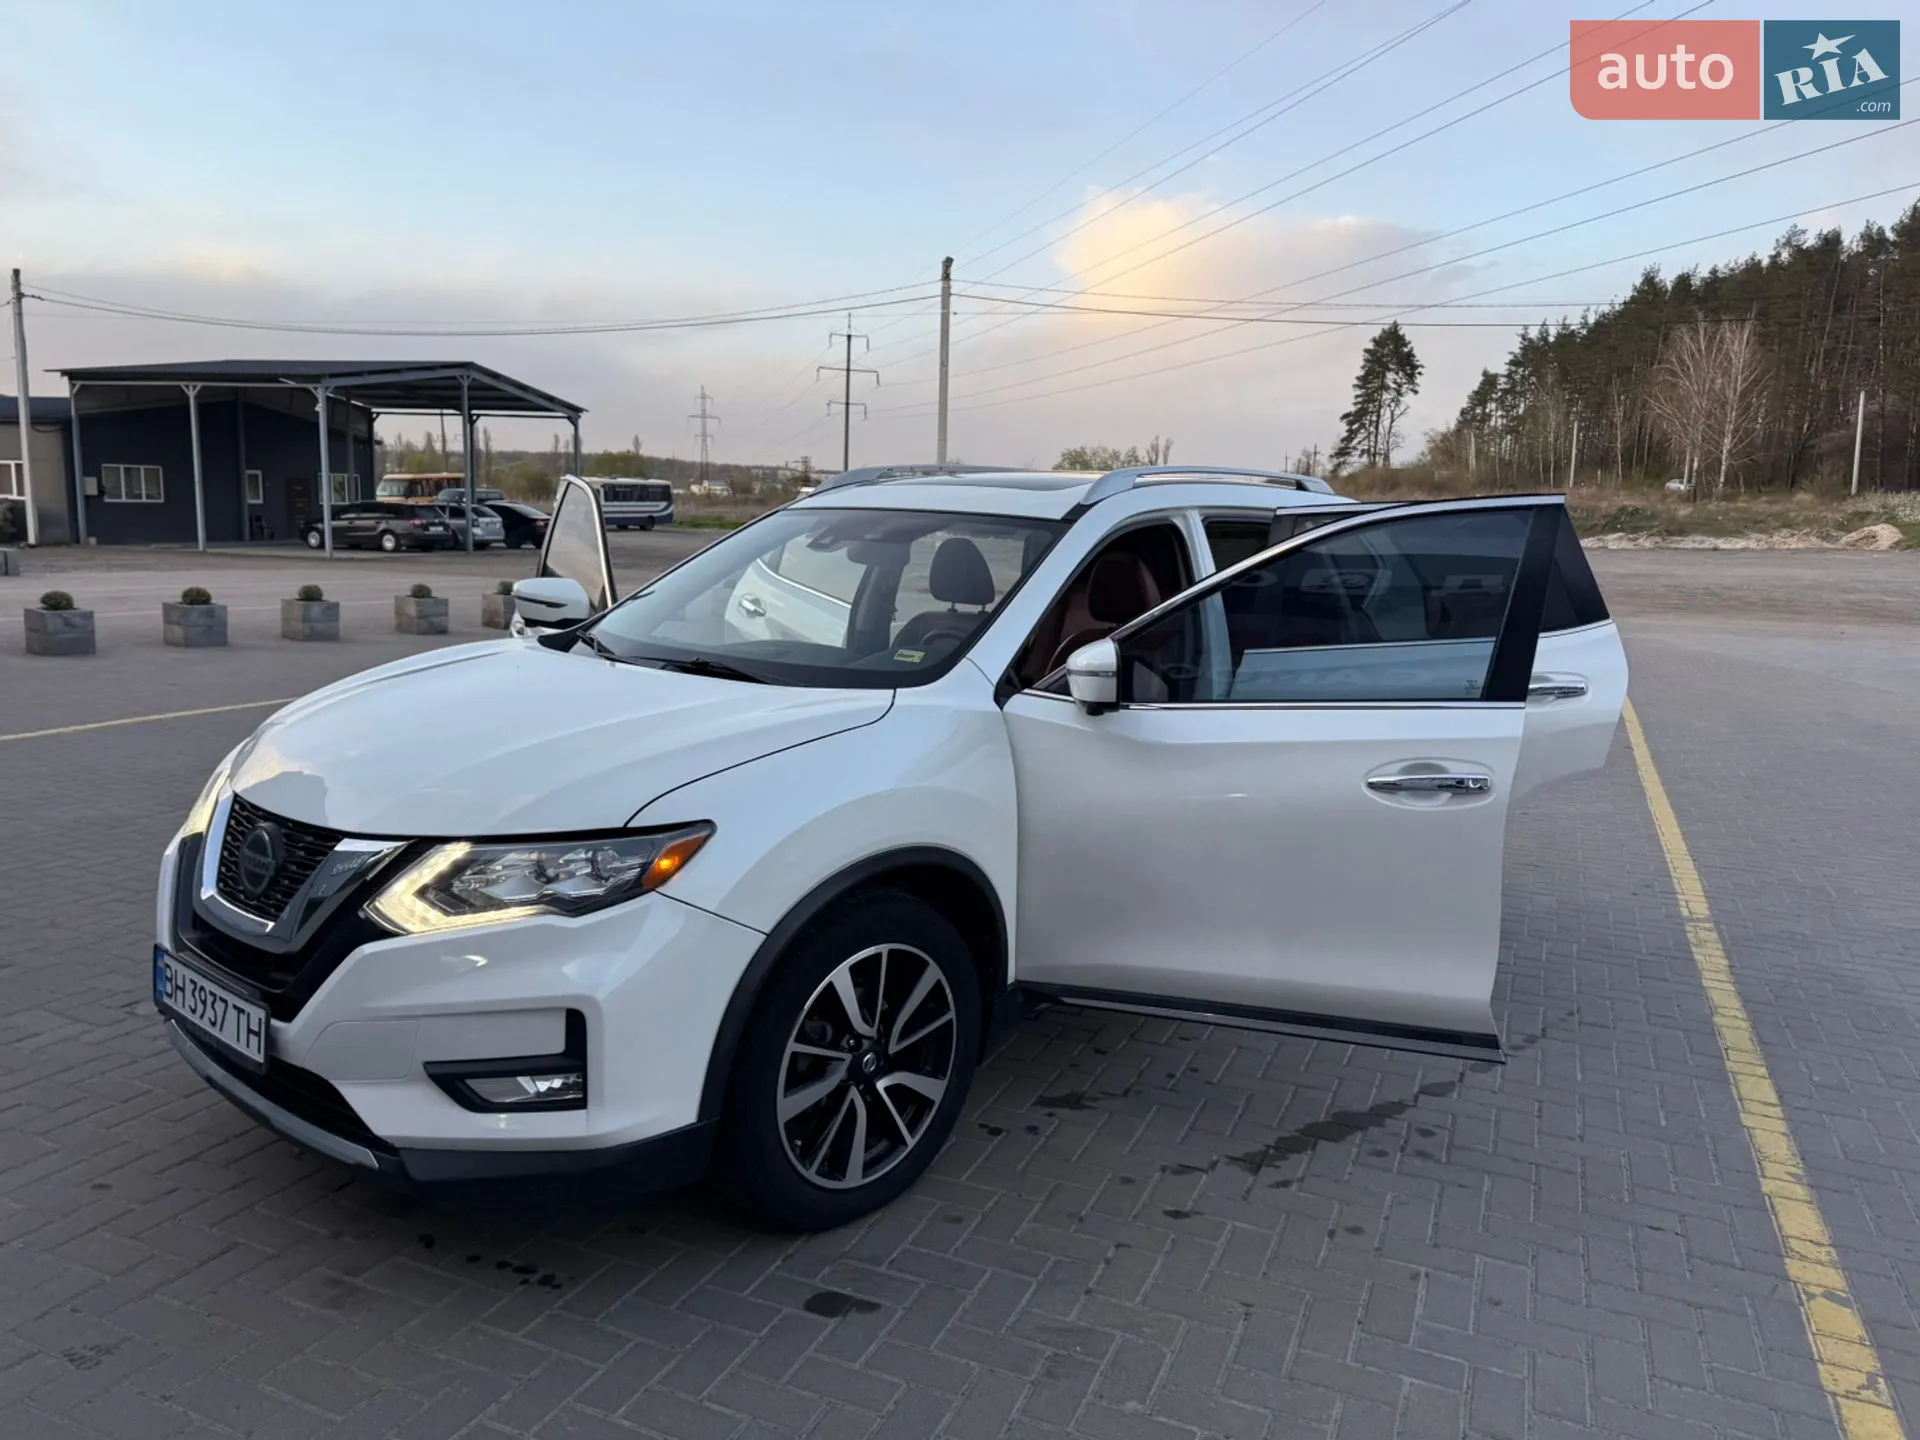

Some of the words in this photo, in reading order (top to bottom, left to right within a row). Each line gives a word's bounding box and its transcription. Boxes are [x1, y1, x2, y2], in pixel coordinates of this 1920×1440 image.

[163, 962, 186, 1009] BH
[188, 978, 229, 1033] 3937
[232, 1003, 262, 1055] TH
